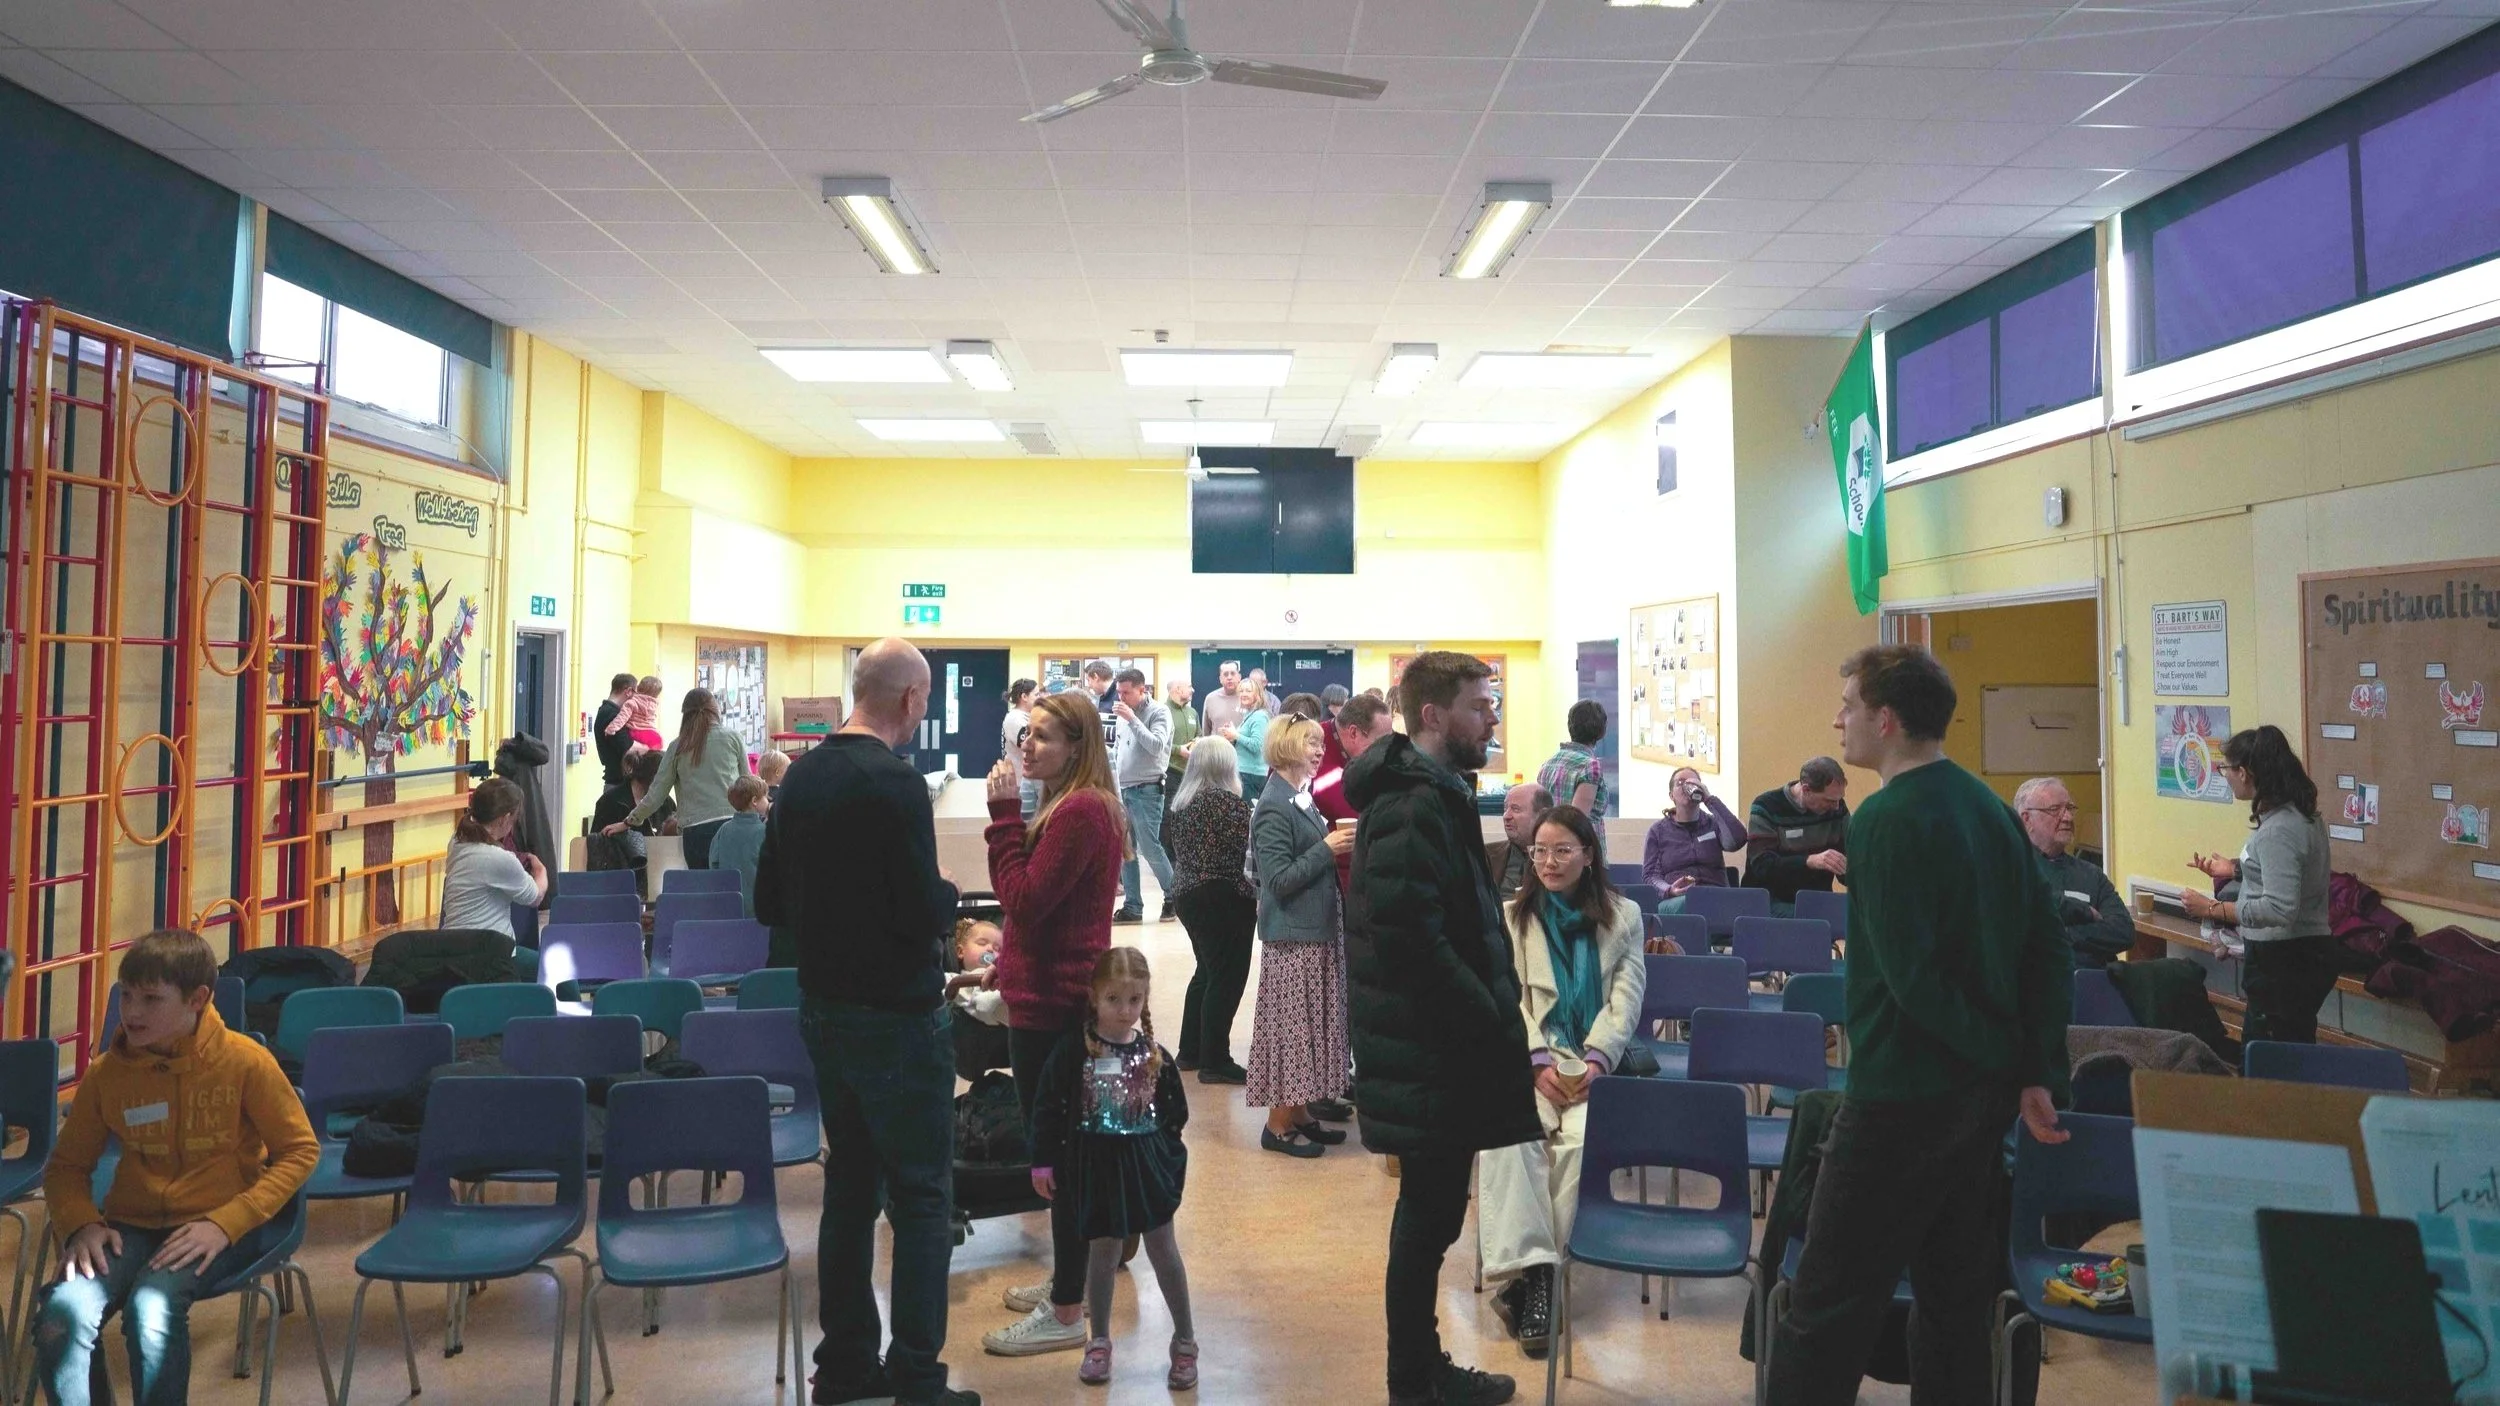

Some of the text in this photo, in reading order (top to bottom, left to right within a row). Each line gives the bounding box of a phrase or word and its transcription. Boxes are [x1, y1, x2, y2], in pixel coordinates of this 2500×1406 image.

[374, 515, 406, 550] Tree
[2324, 581, 2500, 635] Spirituality
[2156, 609, 2220, 624] ST. BART'S WAY
[2163, 637, 2181, 645] Honest
[2166, 648, 2179, 658] High
[2156, 660, 2176, 670] Respect
[2186, 658, 2219, 668] Environment
[2156, 671, 2207, 681] Treat Everyone Well
[2156, 683, 2171, 691] Show
[2181, 683, 2198, 691] Values
